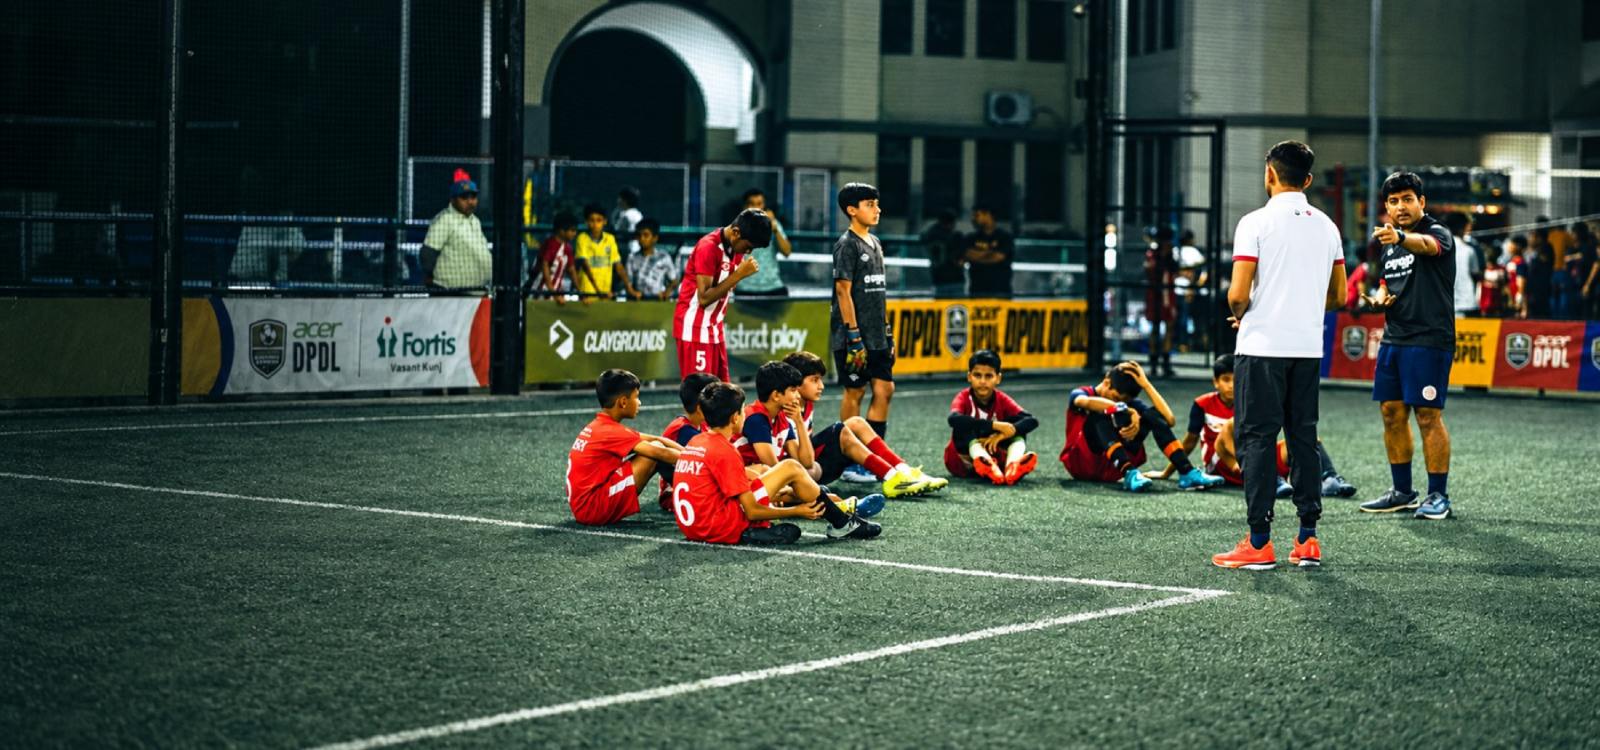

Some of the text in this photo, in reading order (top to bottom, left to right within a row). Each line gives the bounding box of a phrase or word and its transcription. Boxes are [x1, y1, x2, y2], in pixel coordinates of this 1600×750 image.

[293, 321, 343, 338] acer
[584, 329, 667, 354] CLAYGROUNDS
[770, 322, 808, 354] play
[1534, 334, 1571, 346] acer
[402, 330, 456, 357] Fortis
[292, 341, 341, 373] DPDL
[390, 361, 442, 374] Vasant Kunj
[695, 350, 706, 371] 5
[1532, 346, 1570, 369] DPDL
[673, 482, 695, 527] 6
